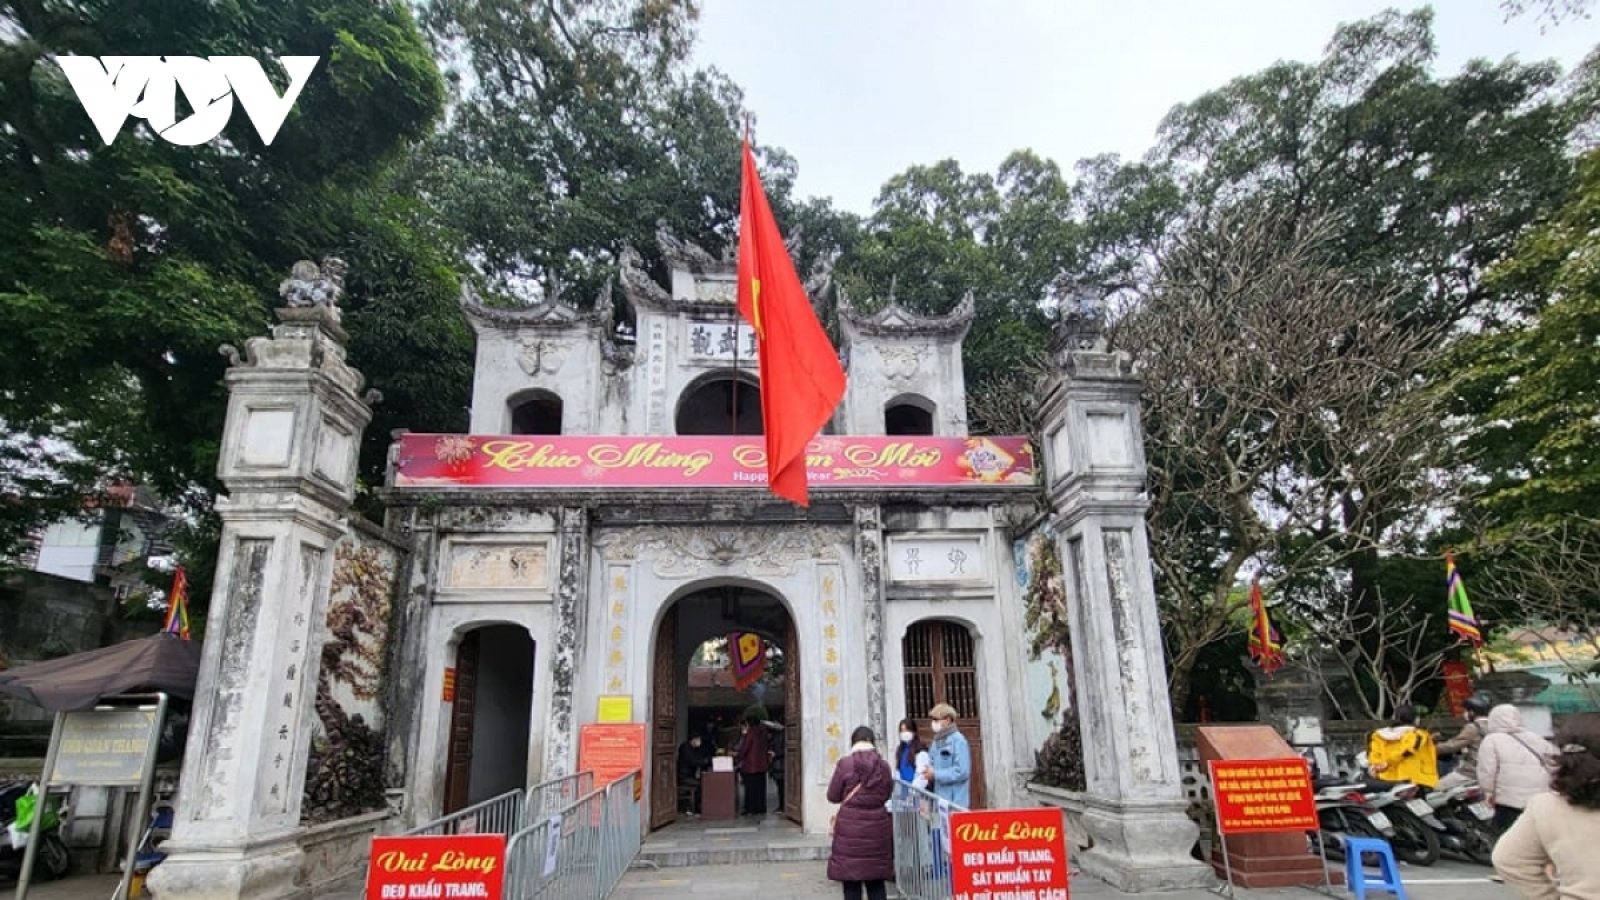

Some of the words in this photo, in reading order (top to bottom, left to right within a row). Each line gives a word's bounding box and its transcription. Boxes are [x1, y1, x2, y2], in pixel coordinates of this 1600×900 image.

[481, 440, 582, 472] Chúc
[956, 824, 999, 842] Vui
[1003, 821, 1057, 842] Lòng
[377, 850, 429, 872] Vui
[432, 849, 497, 875] Lòng
[1032, 868, 1052, 884] TAY
